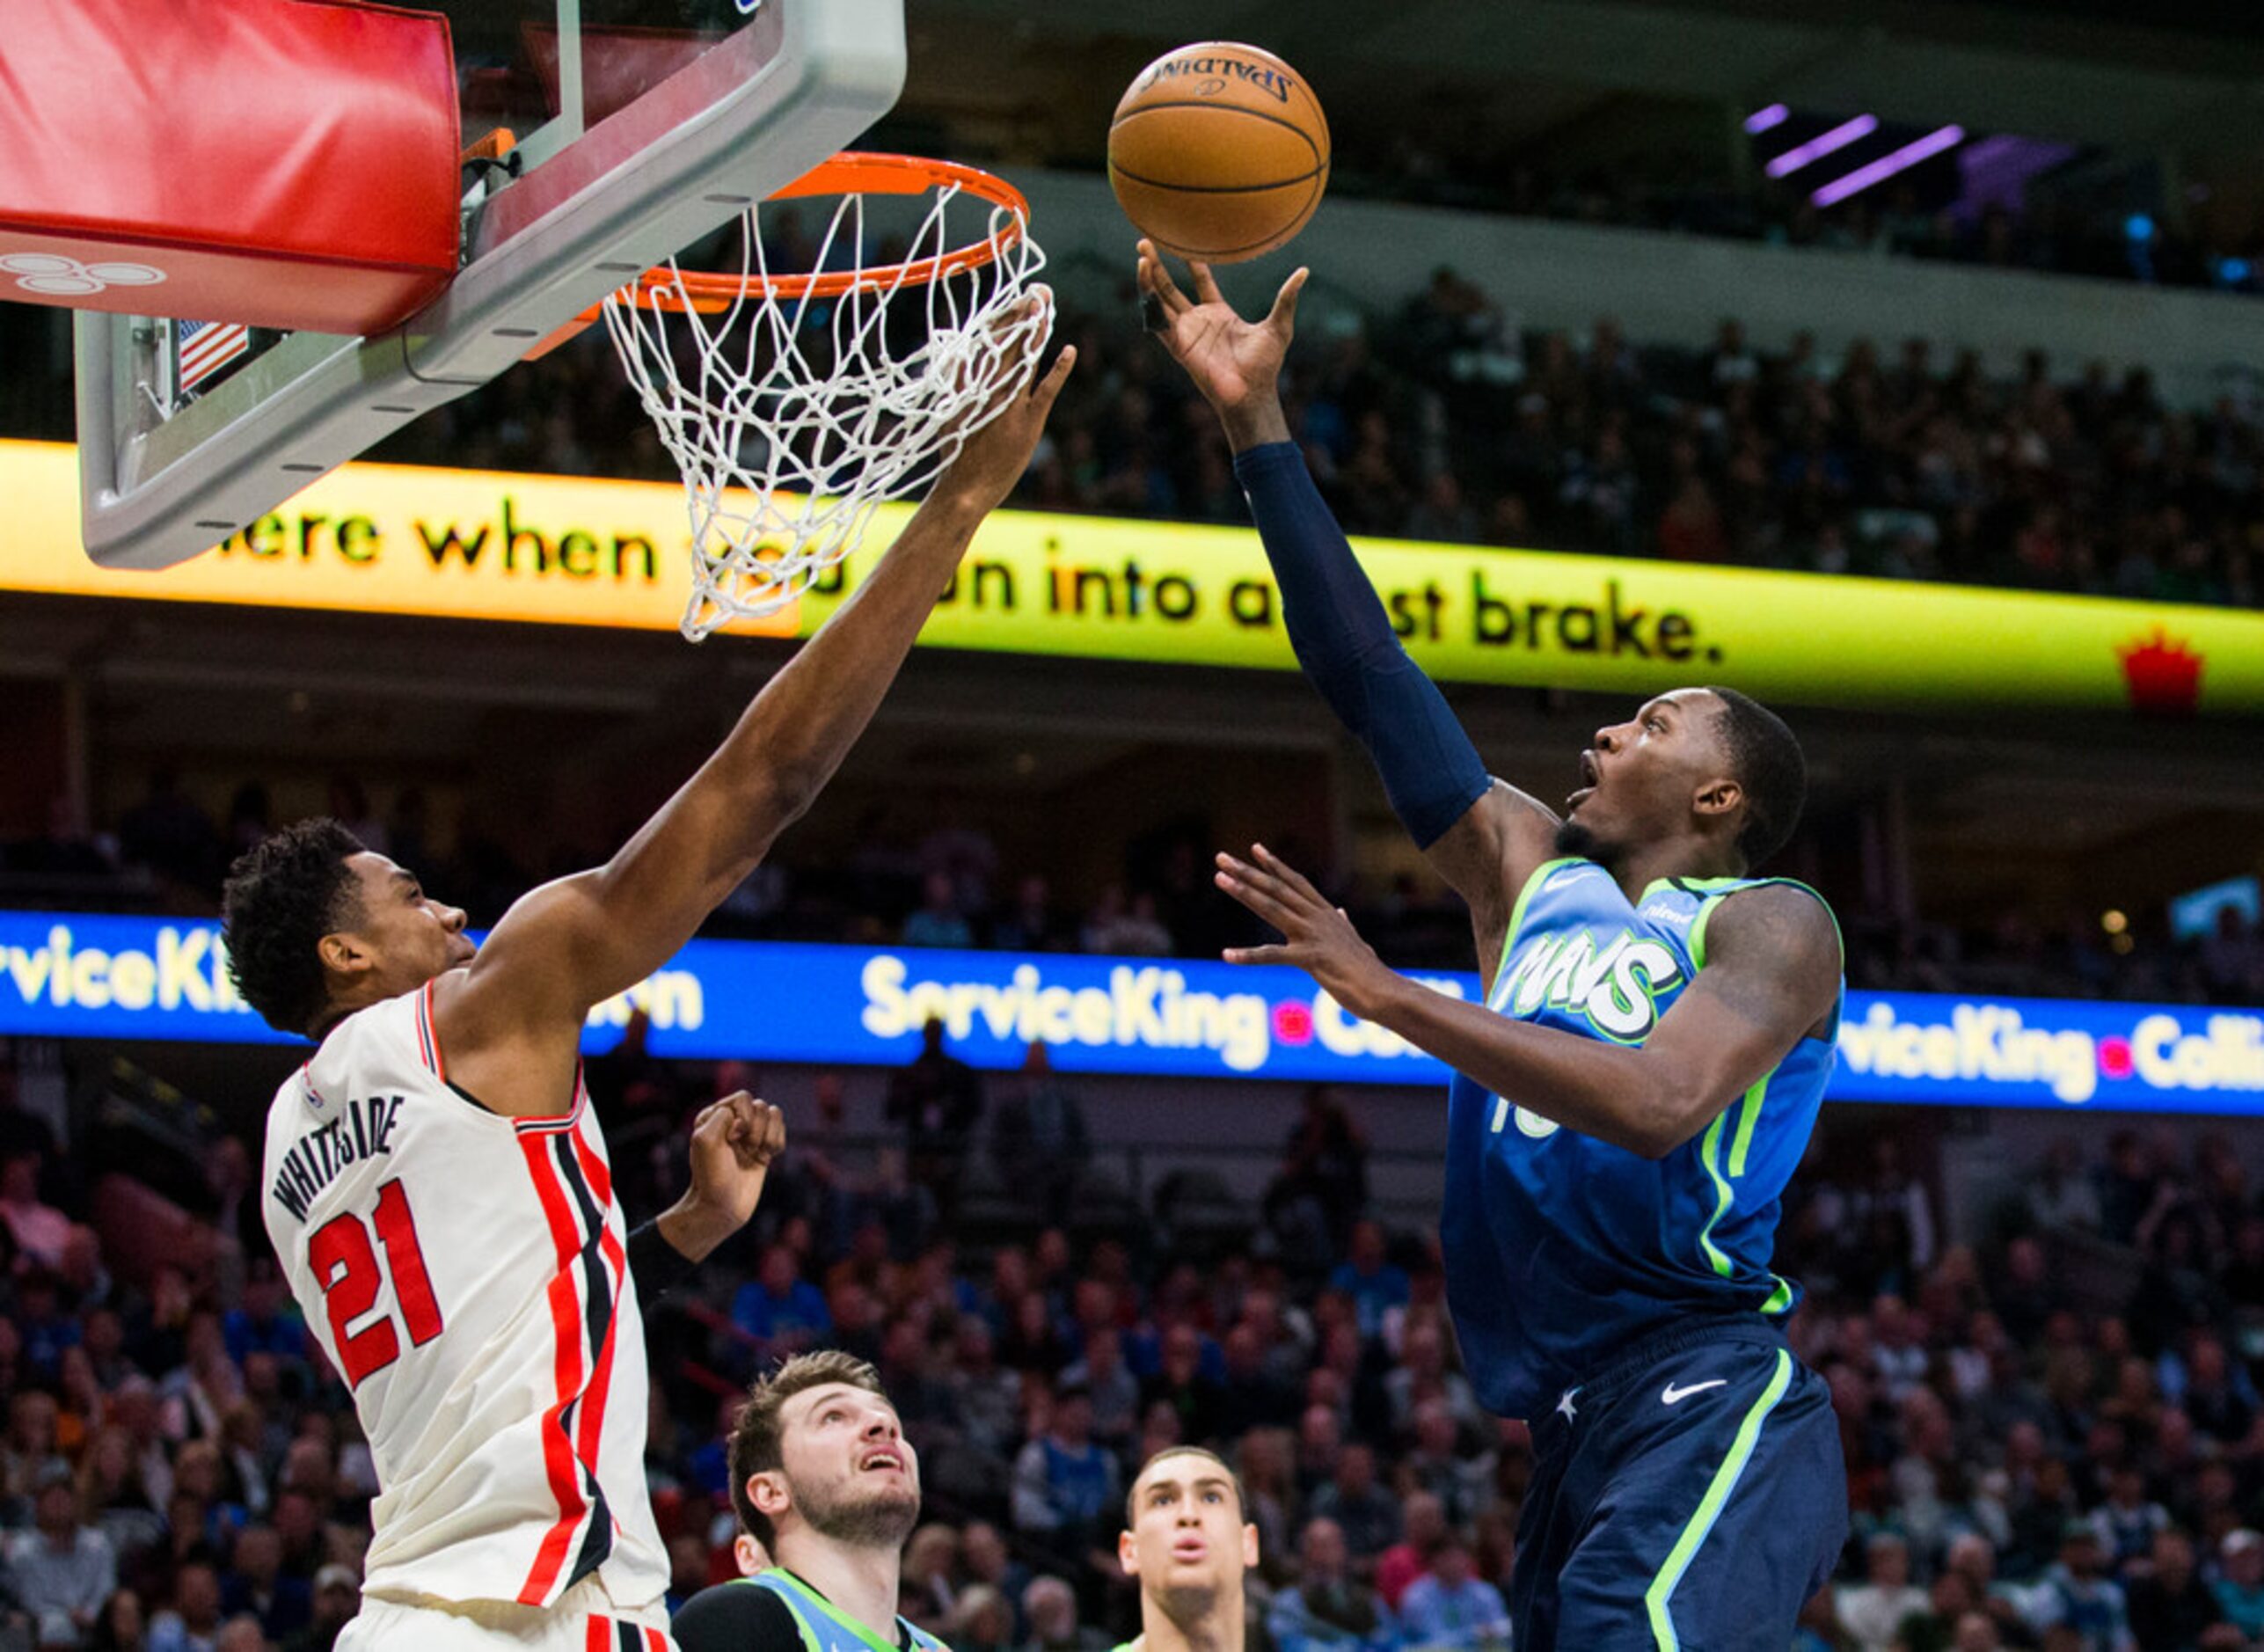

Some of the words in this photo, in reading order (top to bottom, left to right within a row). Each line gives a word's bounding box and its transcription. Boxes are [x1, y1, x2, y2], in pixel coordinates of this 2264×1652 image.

[221, 514, 378, 561] ere
[413, 495, 654, 579] when
[1048, 537, 1197, 620] into
[1231, 581, 1272, 627] a
[1388, 581, 1445, 640] st
[1473, 569, 1722, 662] brake.
[0, 925, 252, 1012] viceKi
[862, 955, 1269, 1071] ServiceKing
[1490, 931, 1685, 1044] MAVS
[308, 1176, 443, 1392] 21
